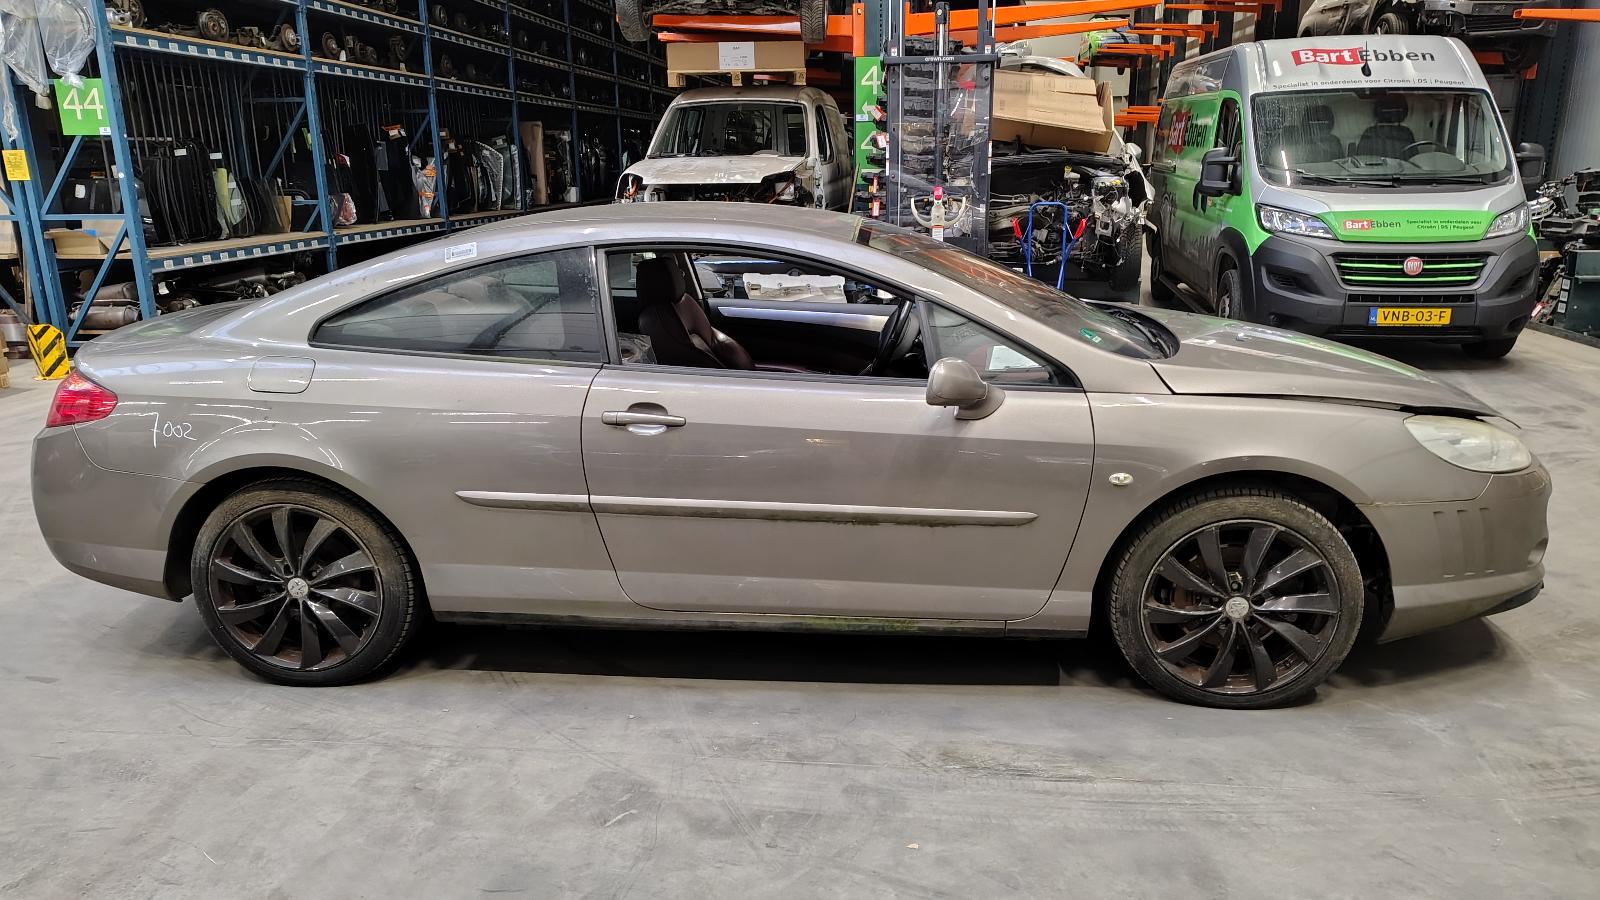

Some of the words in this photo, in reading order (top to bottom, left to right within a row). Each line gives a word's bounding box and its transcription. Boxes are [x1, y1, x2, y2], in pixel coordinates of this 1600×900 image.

[1299, 49, 1354, 63] Bart
[1358, 49, 1436, 62] Ebben
[62, 87, 104, 120] 44
[1345, 220, 1369, 229] Bart
[1370, 220, 1402, 228] Ebben
[1382, 310, 1447, 322] VNB-03-F
[149, 411, 198, 449] 7002
